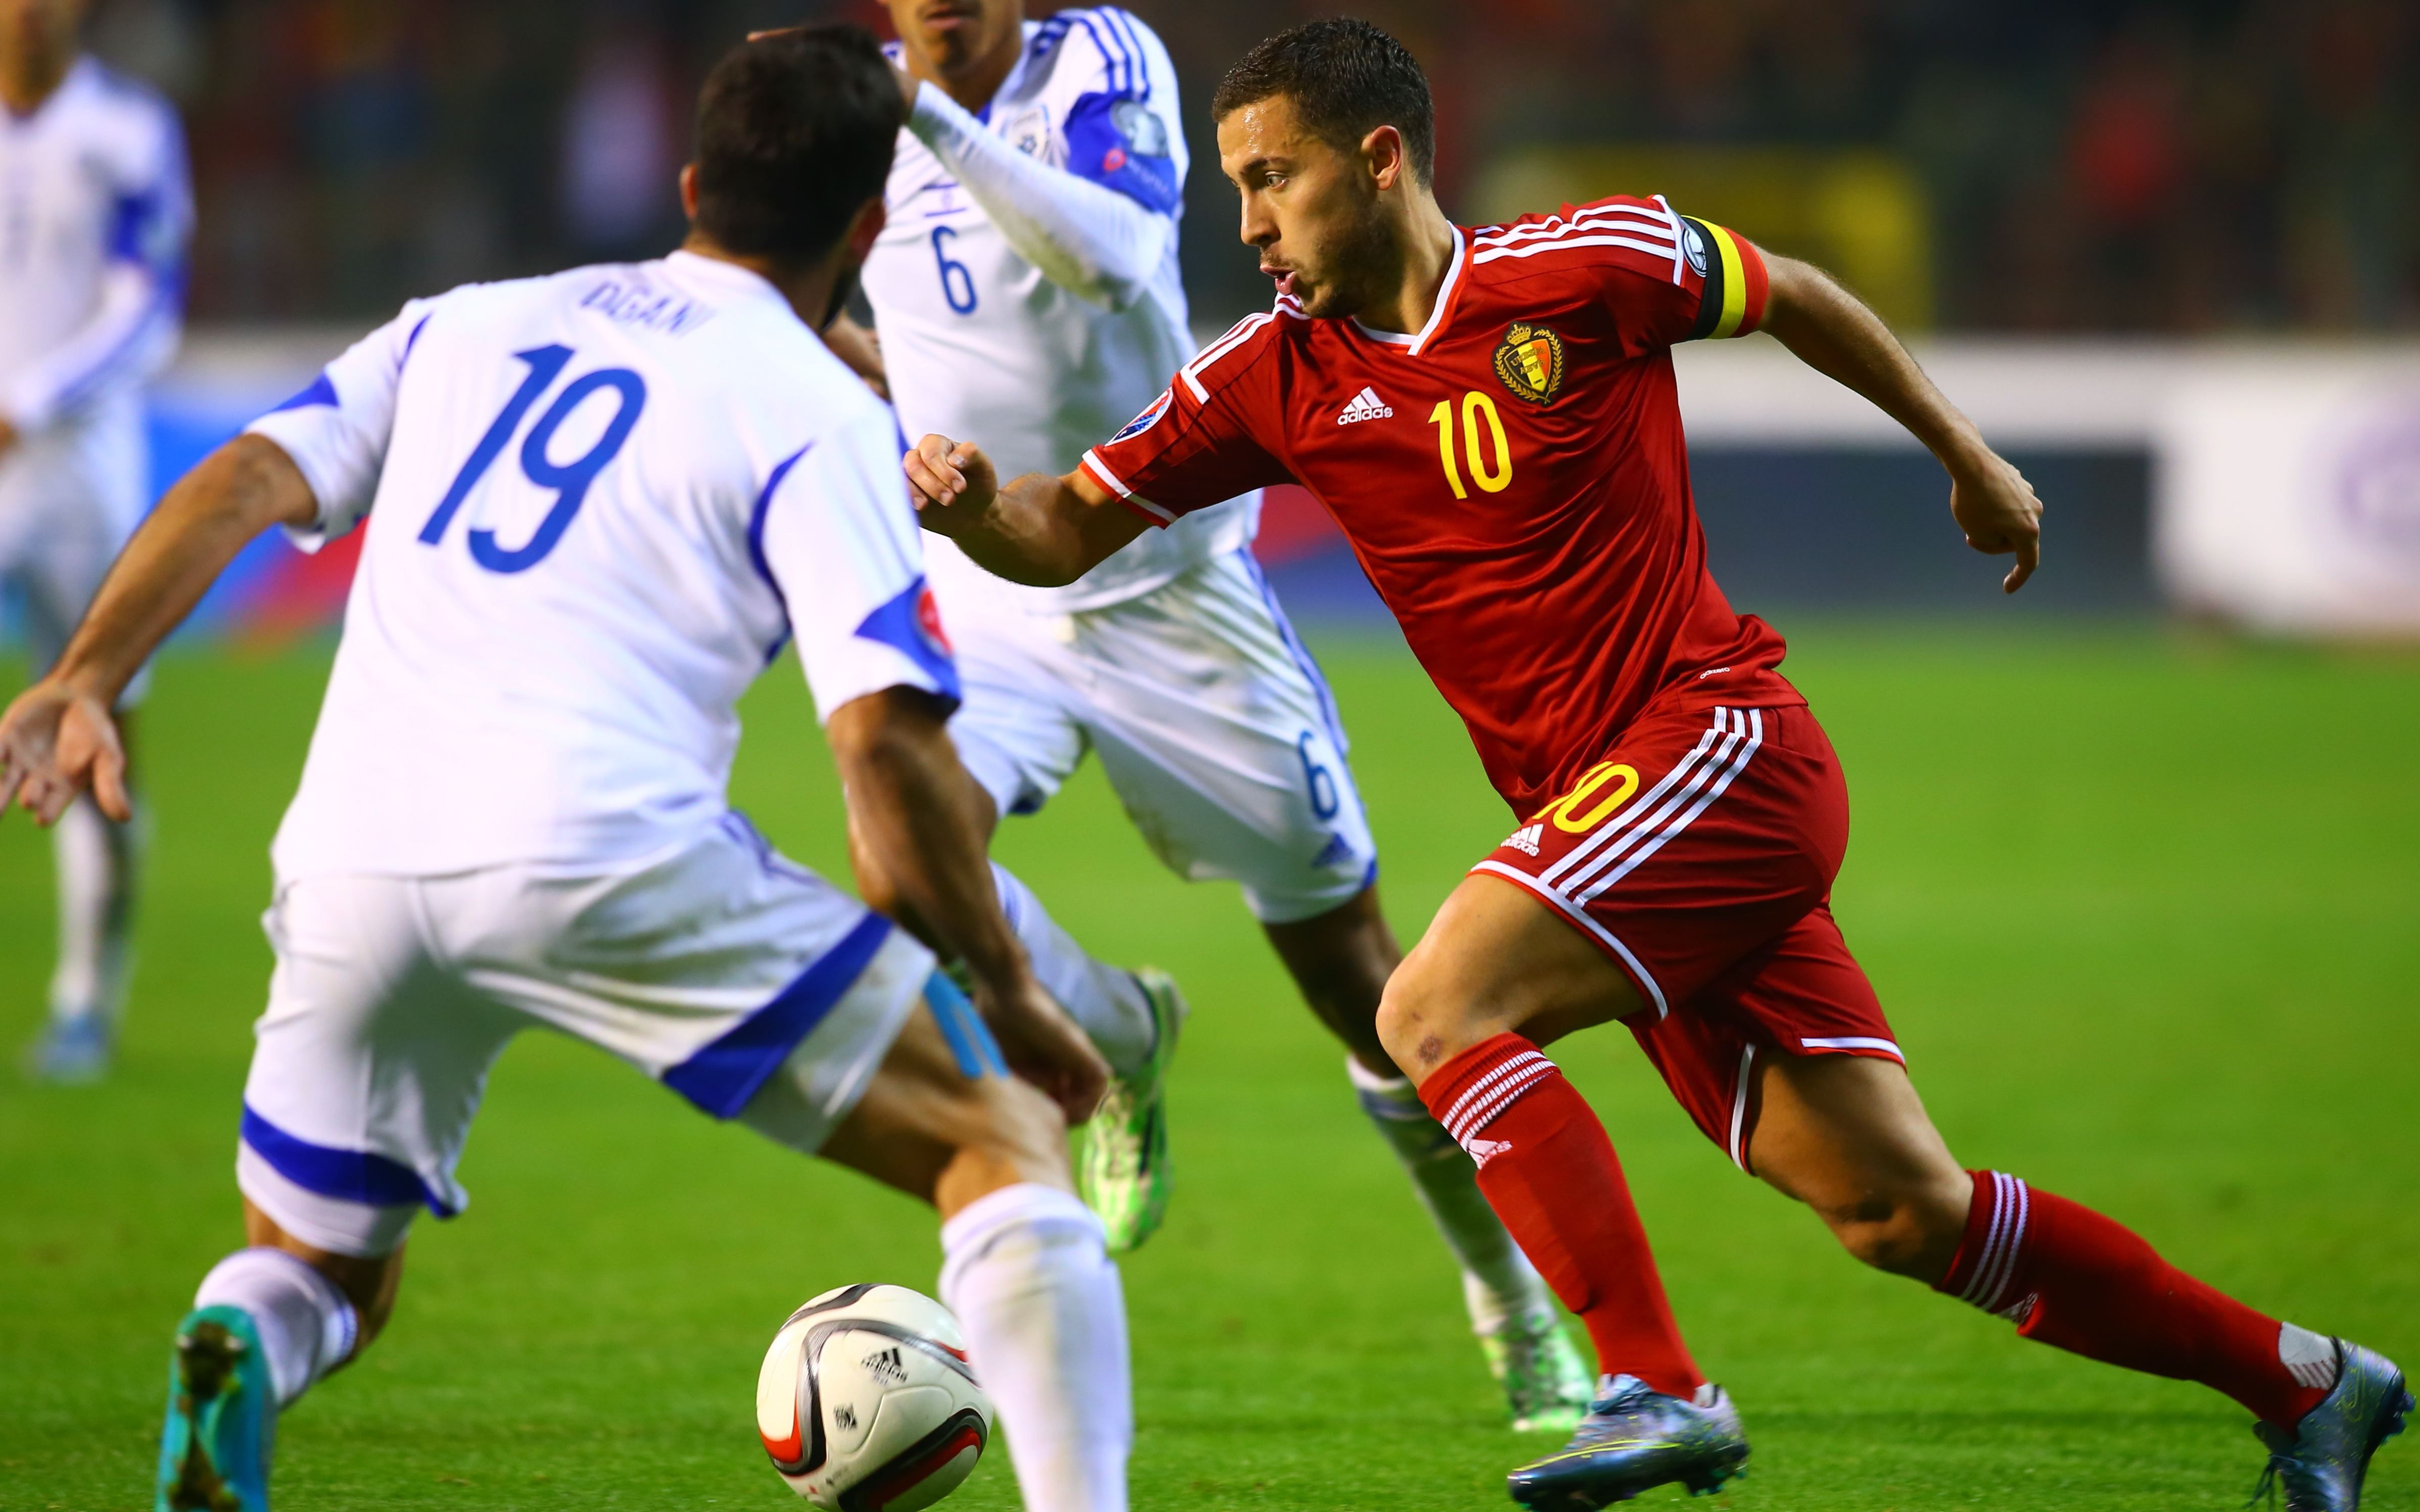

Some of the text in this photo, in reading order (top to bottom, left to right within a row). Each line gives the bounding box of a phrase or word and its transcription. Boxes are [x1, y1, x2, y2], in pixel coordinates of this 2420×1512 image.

[932, 226, 978, 315] 6
[417, 344, 647, 574] 19
[1337, 407, 1393, 425] adidas
[1428, 391, 1513, 500] 10
[1298, 730, 1339, 820] 6
